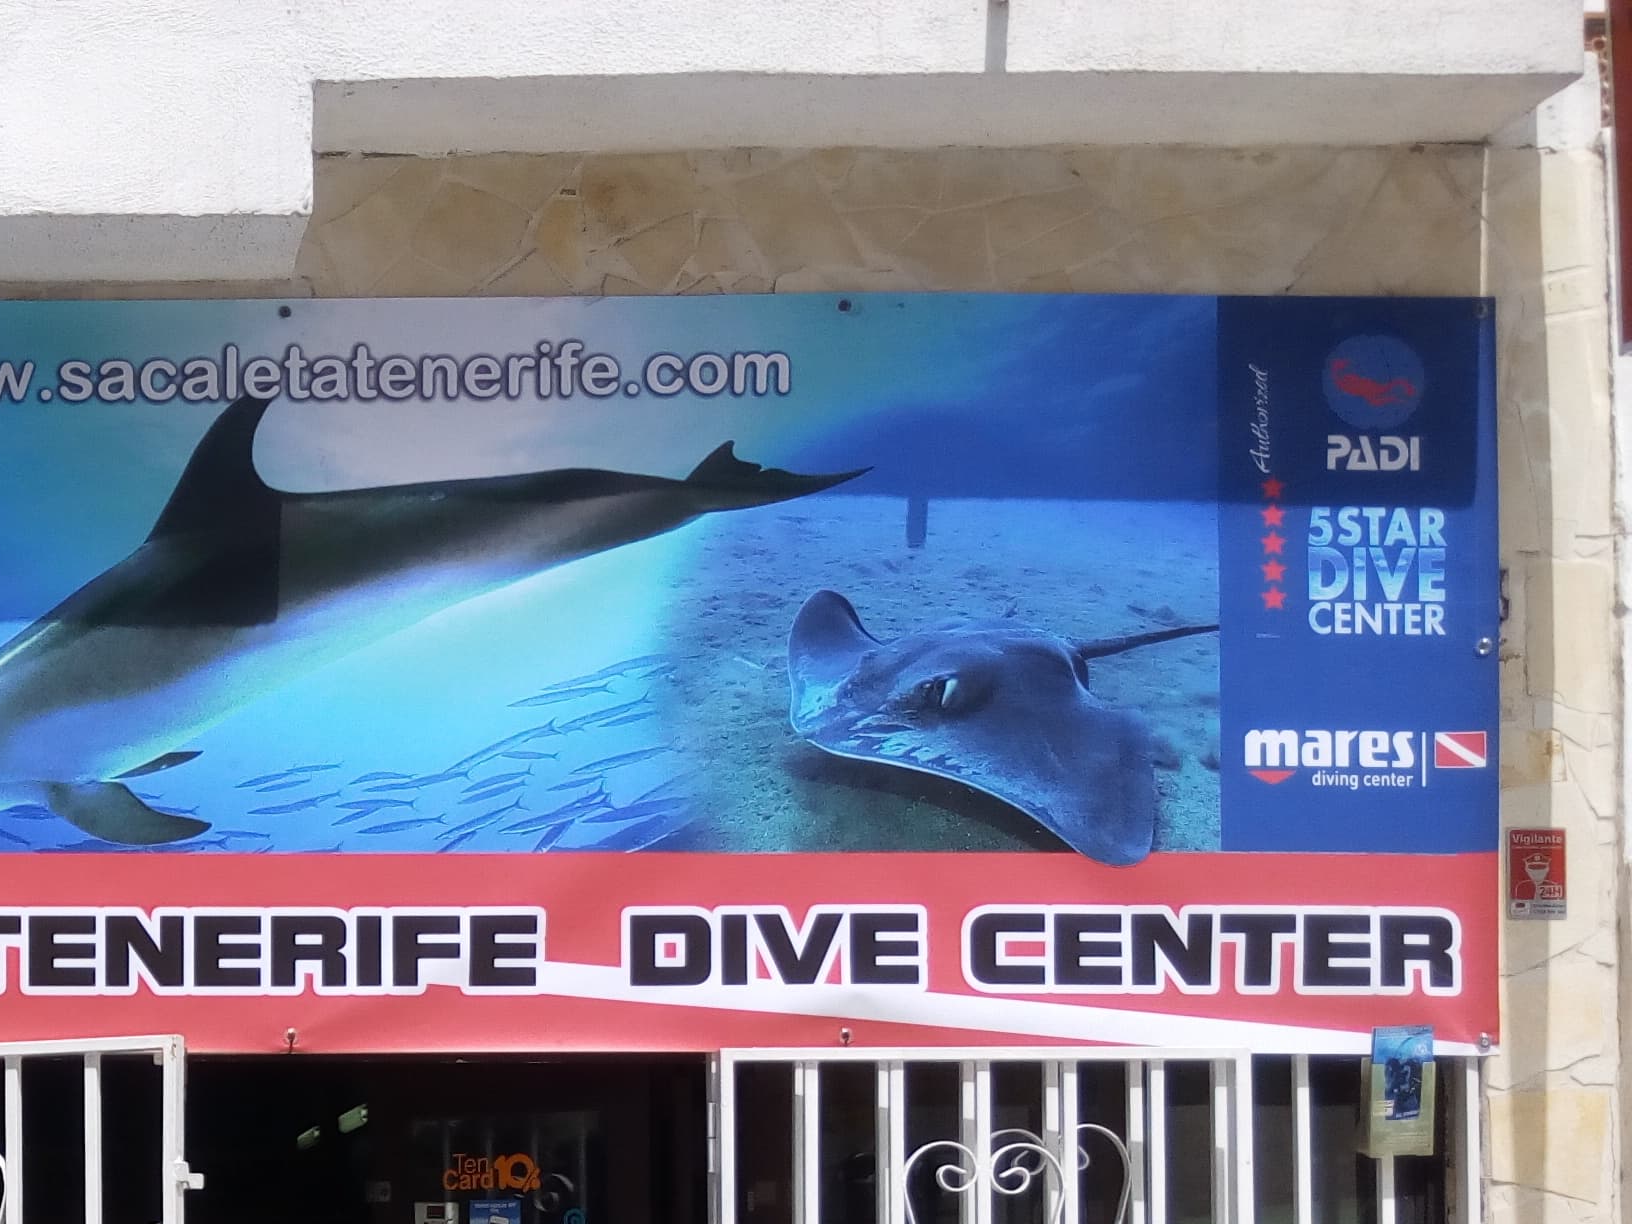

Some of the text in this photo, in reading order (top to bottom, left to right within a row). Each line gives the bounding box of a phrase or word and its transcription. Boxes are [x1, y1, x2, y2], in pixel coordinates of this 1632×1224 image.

[1249, 363, 1272, 474] Authorized
[1327, 434, 1420, 471] PADI
[1308, 547, 1445, 601] DIVE
[1308, 603, 1446, 635] CENTER
[1245, 729, 1415, 768] mares
[1312, 770, 1414, 790] diving center
[1512, 833, 1563, 846] Vigilante
[627, 912, 920, 986] DIVE
[968, 912, 1455, 986] CENTER
[443, 1166, 494, 1190] Card
[453, 1154, 489, 1174] Ten
